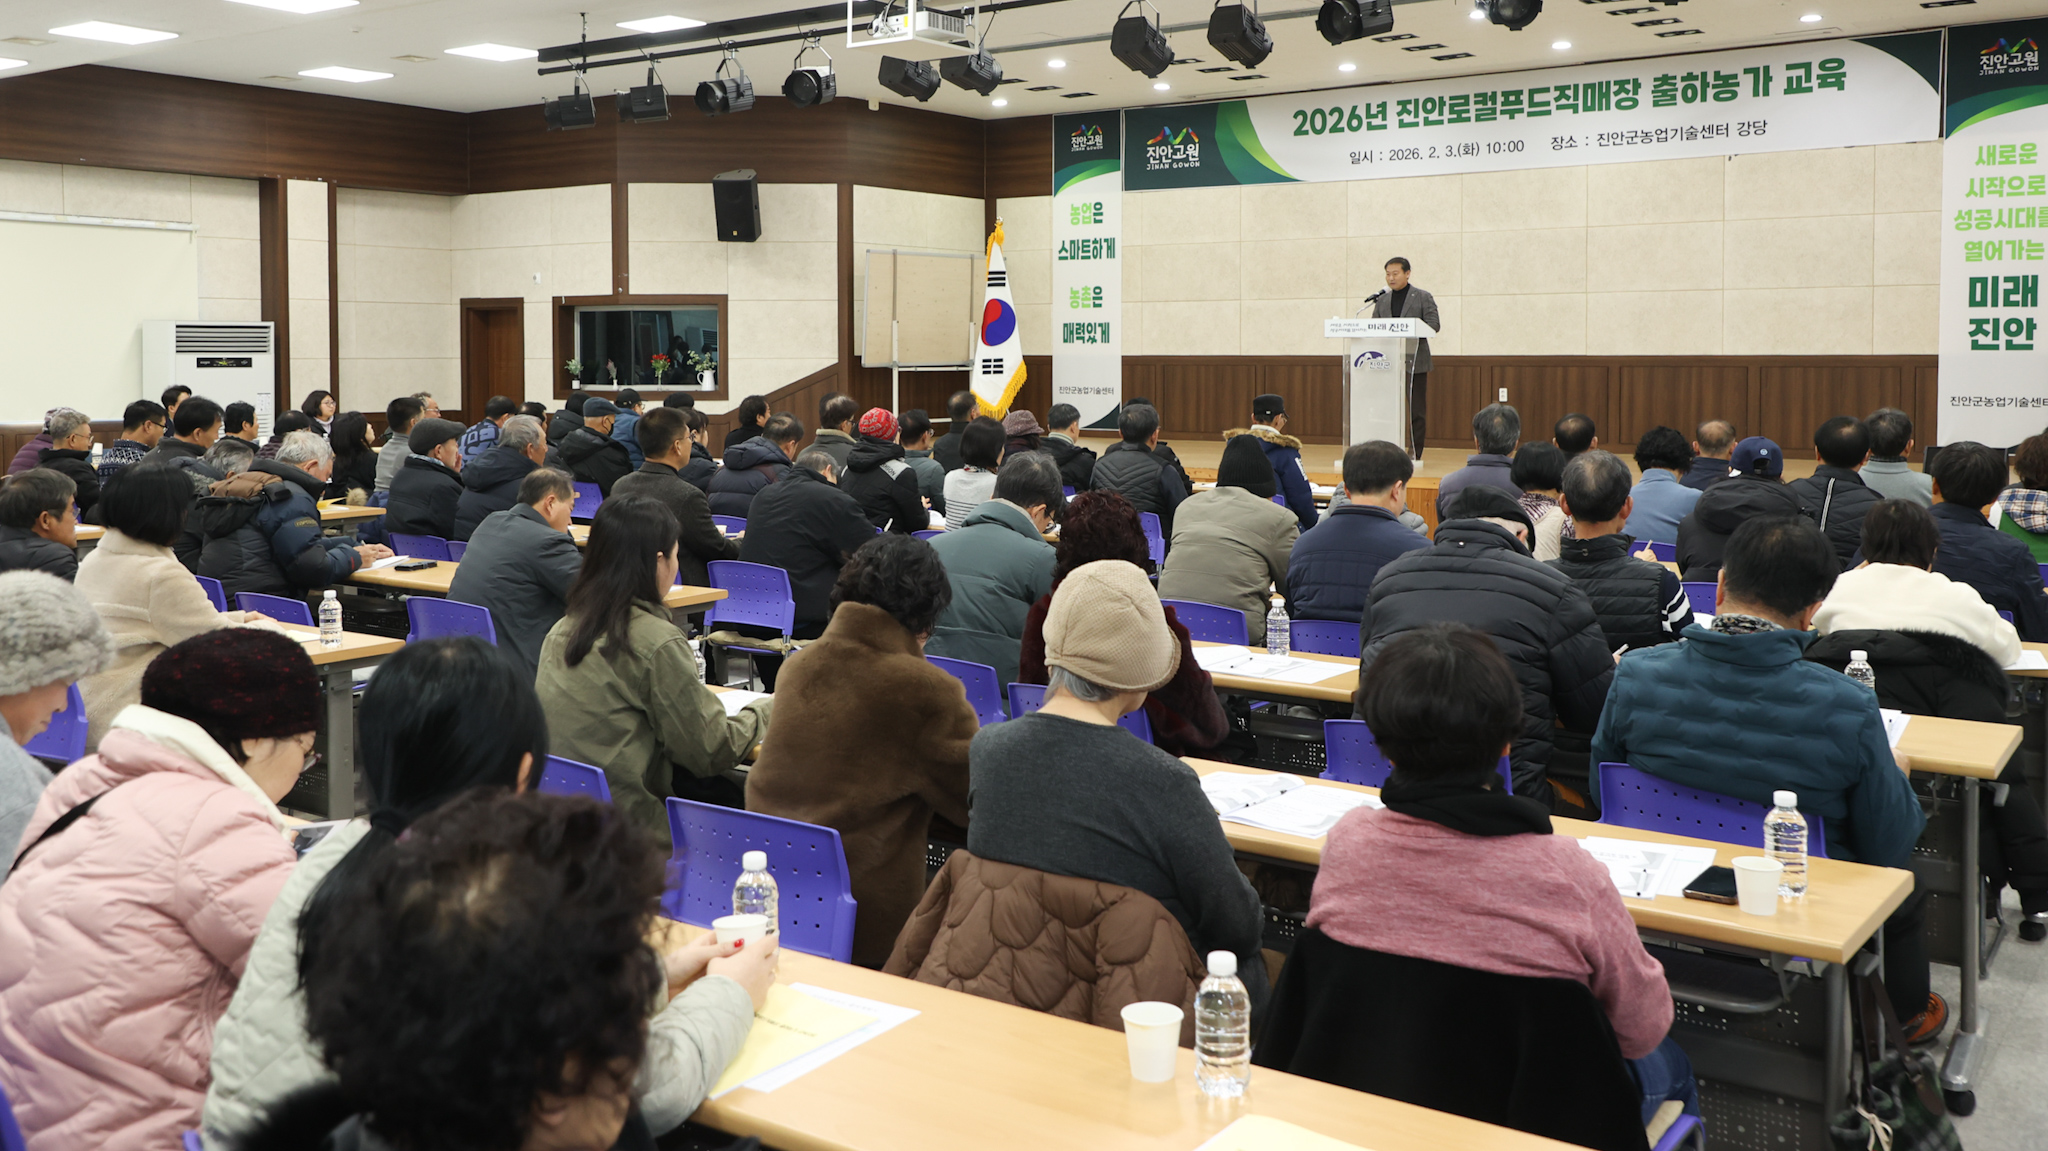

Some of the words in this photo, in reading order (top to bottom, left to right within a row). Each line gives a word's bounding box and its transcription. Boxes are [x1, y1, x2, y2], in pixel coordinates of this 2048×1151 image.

[1979, 51, 2039, 70] 진안고원
[2008, 66, 2040, 74] GOWON
[1293, 101, 1388, 136] 2026년
[1396, 77, 1641, 129] 진안로컬푸드직매장
[1651, 65, 1773, 108] 출하농가
[1783, 57, 1847, 95] 교육
[1071, 135, 1103, 148] 진안고원
[1349, 151, 1374, 165] 일시
[1389, 147, 1424, 161] 2026.
[1428, 146, 1440, 159] 2.
[1445, 142, 1480, 158] 3.(화)
[1486, 140, 1525, 155] 10:00
[1550, 133, 1579, 151] 장소
[1597, 123, 1730, 148] 진안군농업기술센터
[1737, 120, 1768, 137] 강당
[1146, 143, 1199, 164] 진안고원
[1975, 143, 2038, 166] 새로운
[1146, 163, 1170, 171] JINAN
[1172, 161, 1200, 169] GOWON
[1965, 174, 2047, 198] 시작으로
[1070, 202, 1104, 226] 농업은
[1058, 237, 1116, 261] 스마트하게
[1964, 239, 2045, 262] 열어가는
[1069, 285, 1103, 309] 농촌은
[1968, 274, 2039, 308] 미래
[1063, 322, 1110, 345] 매력있게
[1388, 323, 1409, 332] 진안
[1968, 317, 2037, 351] 진안
[1059, 386, 1114, 396] 진안군농업기술센터
